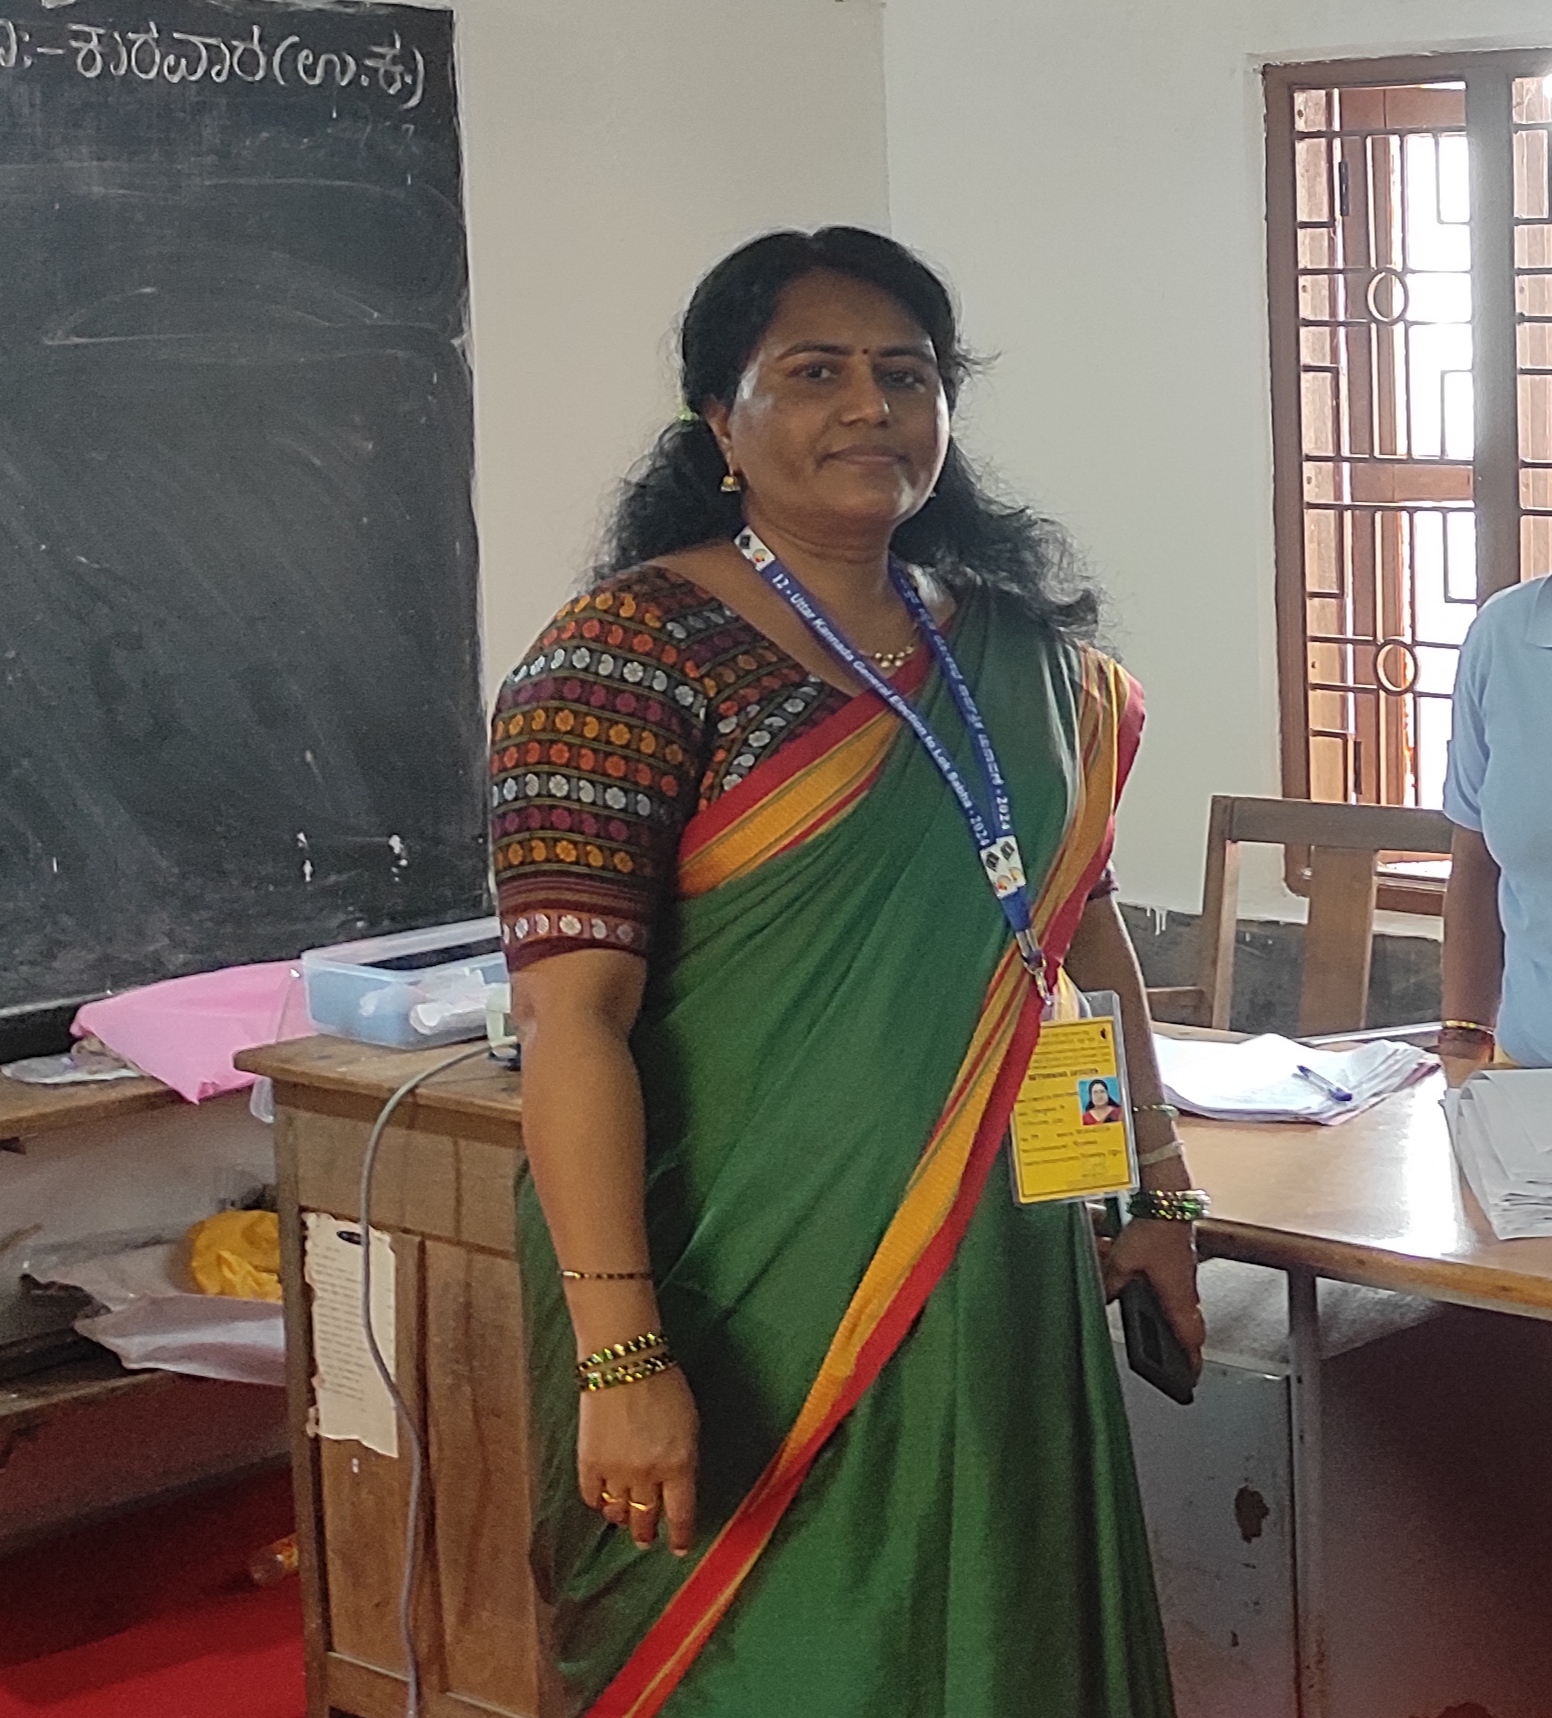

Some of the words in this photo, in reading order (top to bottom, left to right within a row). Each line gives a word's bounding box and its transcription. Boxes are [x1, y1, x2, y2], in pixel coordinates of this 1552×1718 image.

[790, 593, 816, 619] Uttar
[812, 617, 855, 661] Kannada
[853, 660, 893, 697] General
[888, 695, 928, 736] Election
[924, 735, 936, 749] to
[932, 748, 952, 774] Lok
[949, 771, 973, 809] Sabha
[969, 814, 991, 847] 2024
[996, 796, 1011, 831] 2024
